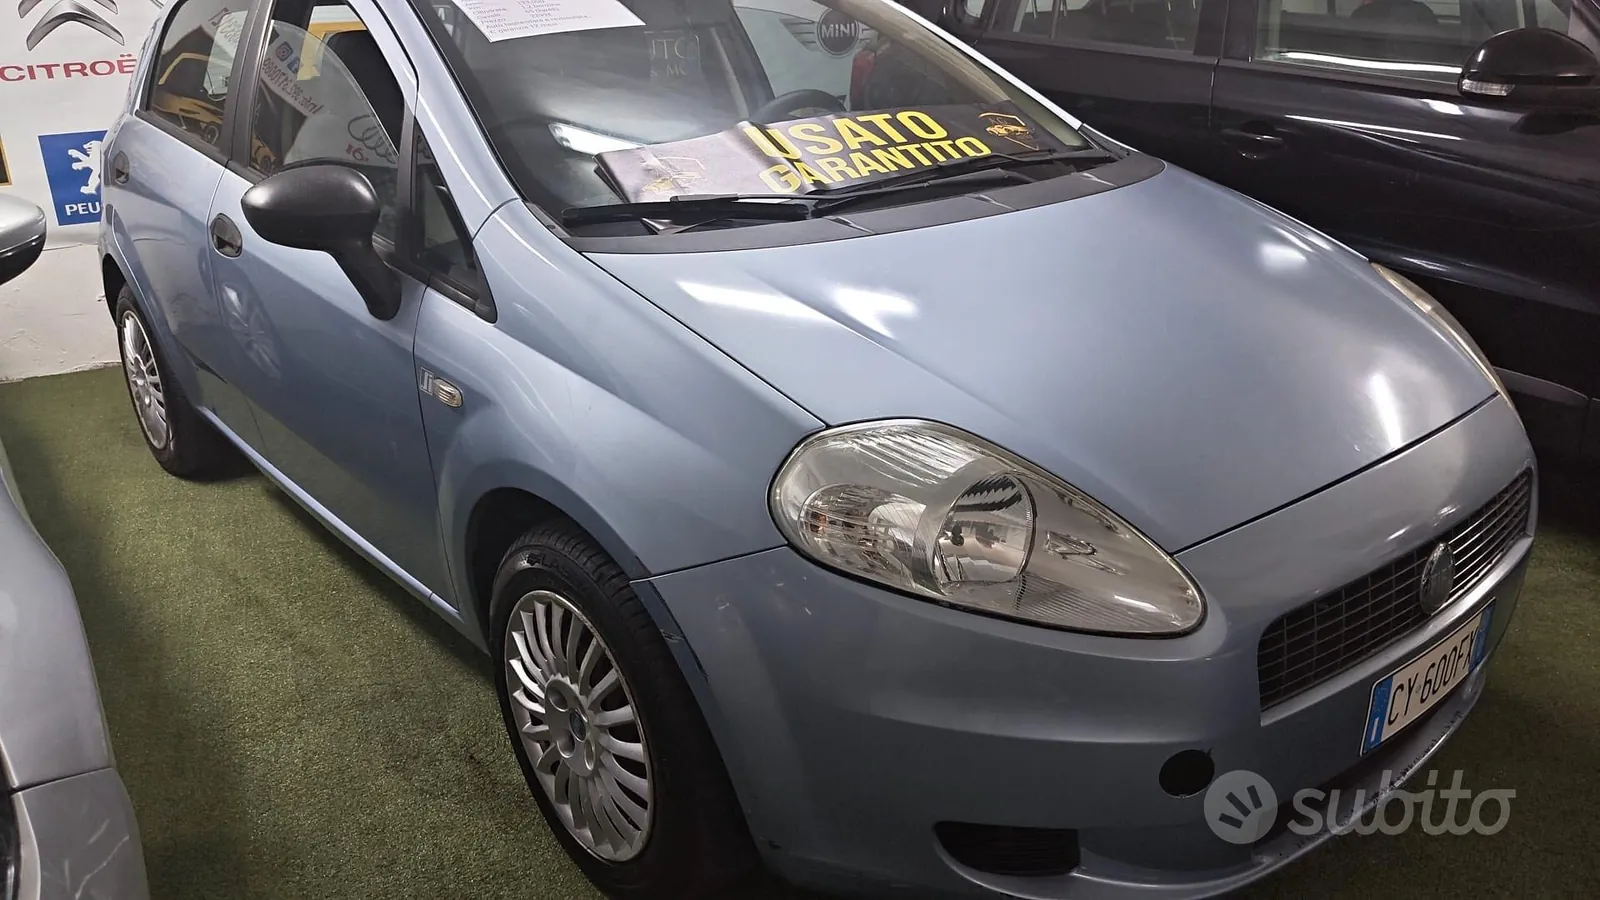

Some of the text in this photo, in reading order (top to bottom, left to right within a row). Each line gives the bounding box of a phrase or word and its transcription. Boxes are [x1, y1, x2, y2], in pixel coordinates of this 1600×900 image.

[821, 23, 855, 38] MINI
[743, 111, 948, 160] USATO
[759, 136, 992, 194] GARANTITO
[1387, 672, 1419, 726] CY
